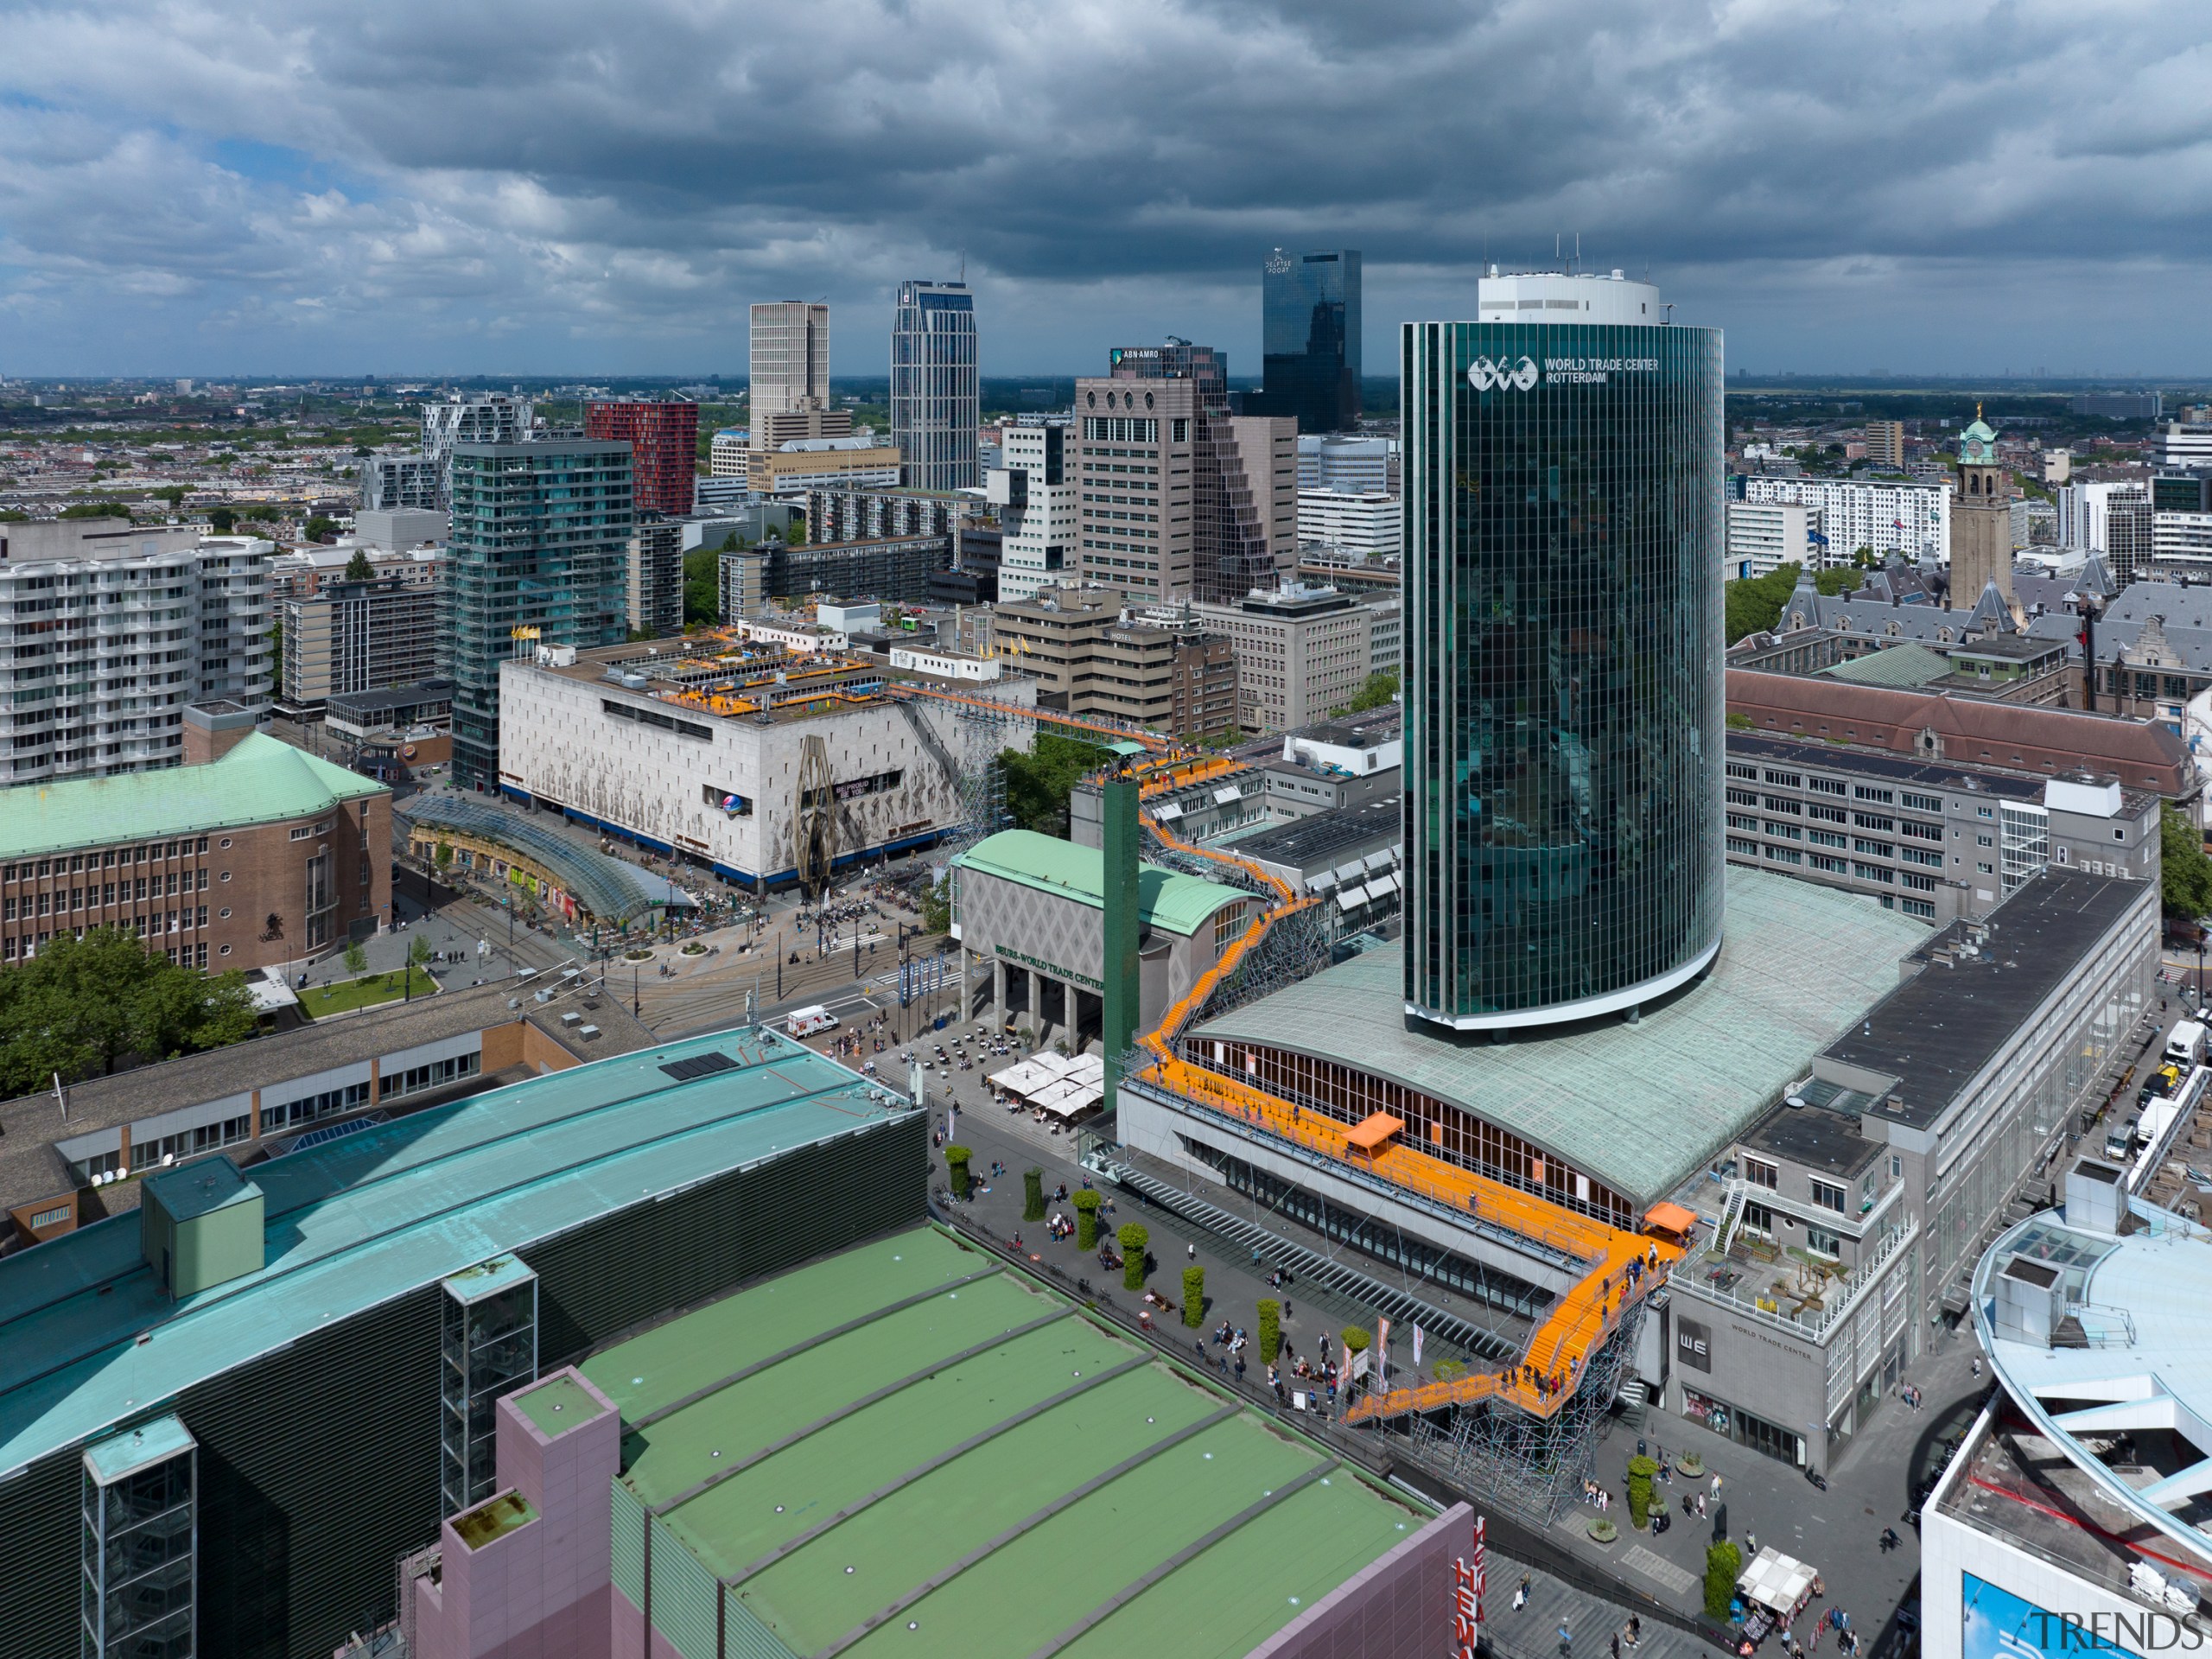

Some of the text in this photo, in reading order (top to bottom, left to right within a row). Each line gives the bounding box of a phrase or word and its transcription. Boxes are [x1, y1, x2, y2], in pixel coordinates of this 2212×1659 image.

[1545, 358, 1659, 371] WORLD TRADE CENTER
[1546, 372, 1606, 384] ROTTERDAM
[1111, 632, 1132, 642] HOTEL
[836, 780, 869, 793] BE PROUD
[851, 787, 864, 796] YOU
[1048, 963, 1074, 980] TRADE
[1680, 1332, 1707, 1356] WE
[1732, 1323, 1812, 1361] WORLD TRADE CENTER
